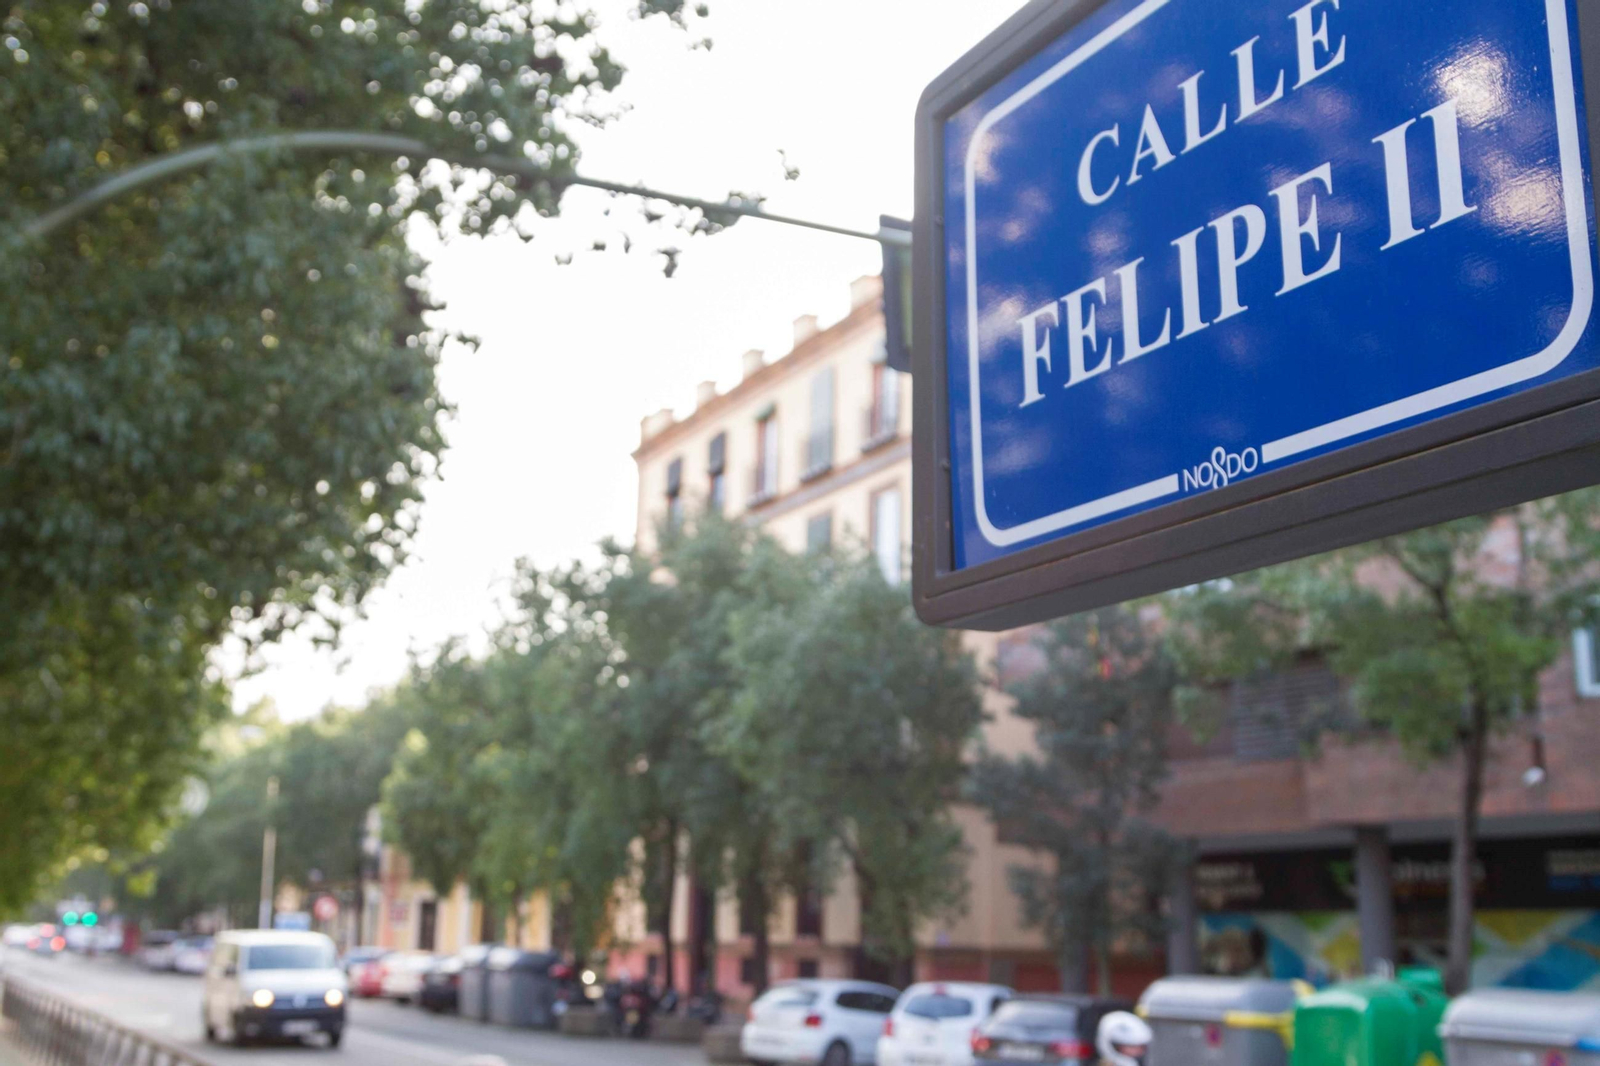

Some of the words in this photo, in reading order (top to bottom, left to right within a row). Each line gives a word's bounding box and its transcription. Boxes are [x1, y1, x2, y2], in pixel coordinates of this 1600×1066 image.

[1077, 0, 1346, 206] CALLE
[1018, 162, 1341, 407] FELIPE
[1372, 98, 1477, 251] II
